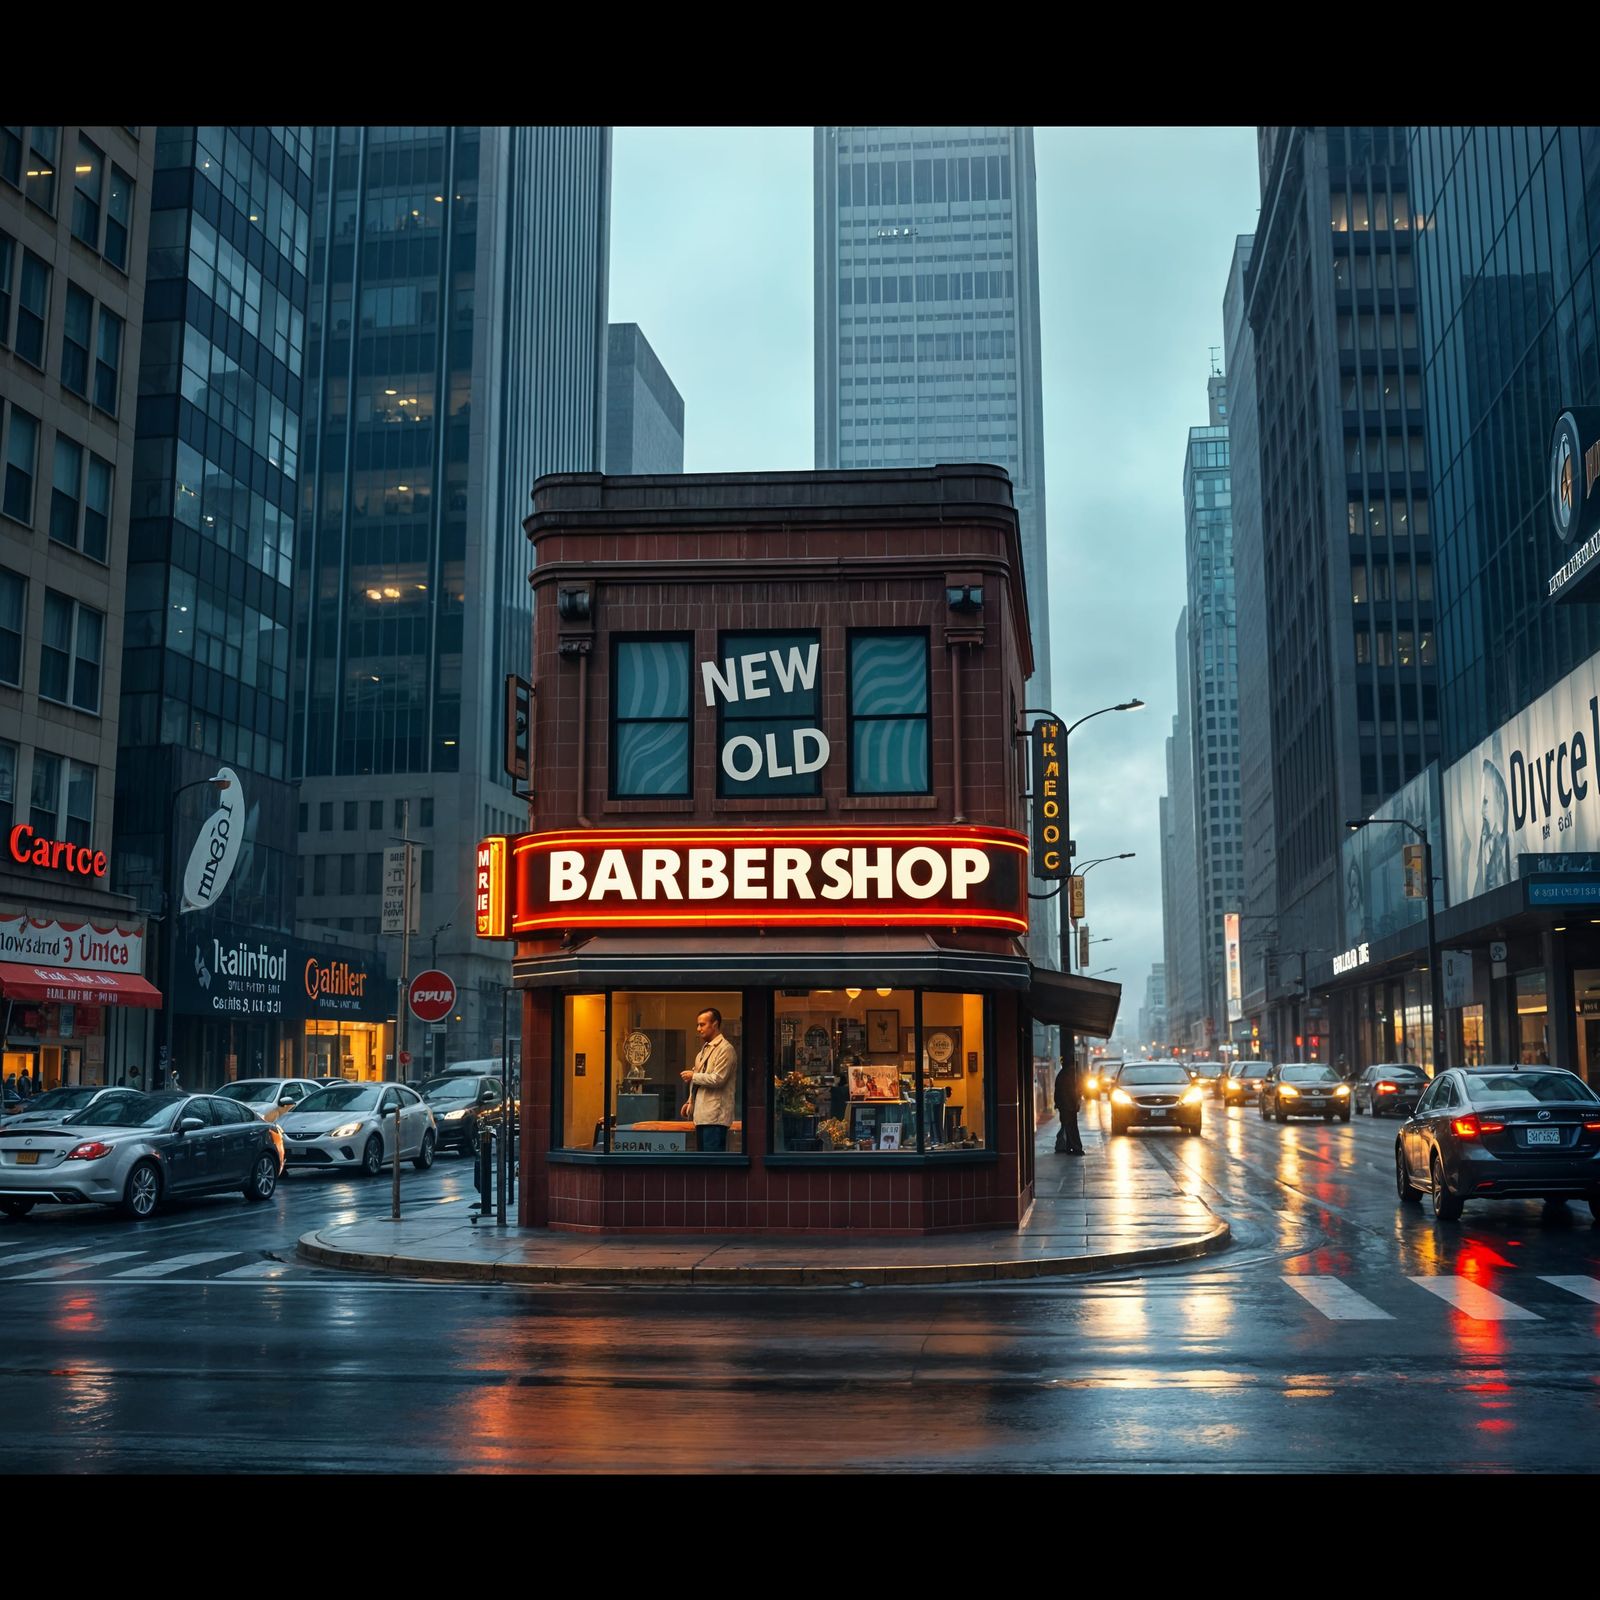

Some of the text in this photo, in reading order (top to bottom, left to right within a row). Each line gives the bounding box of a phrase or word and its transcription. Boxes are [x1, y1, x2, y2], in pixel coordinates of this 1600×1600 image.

[701, 643, 820, 707] NEW
[721, 727, 831, 782] OLD
[549, 846, 991, 902] BARBERSHOP
